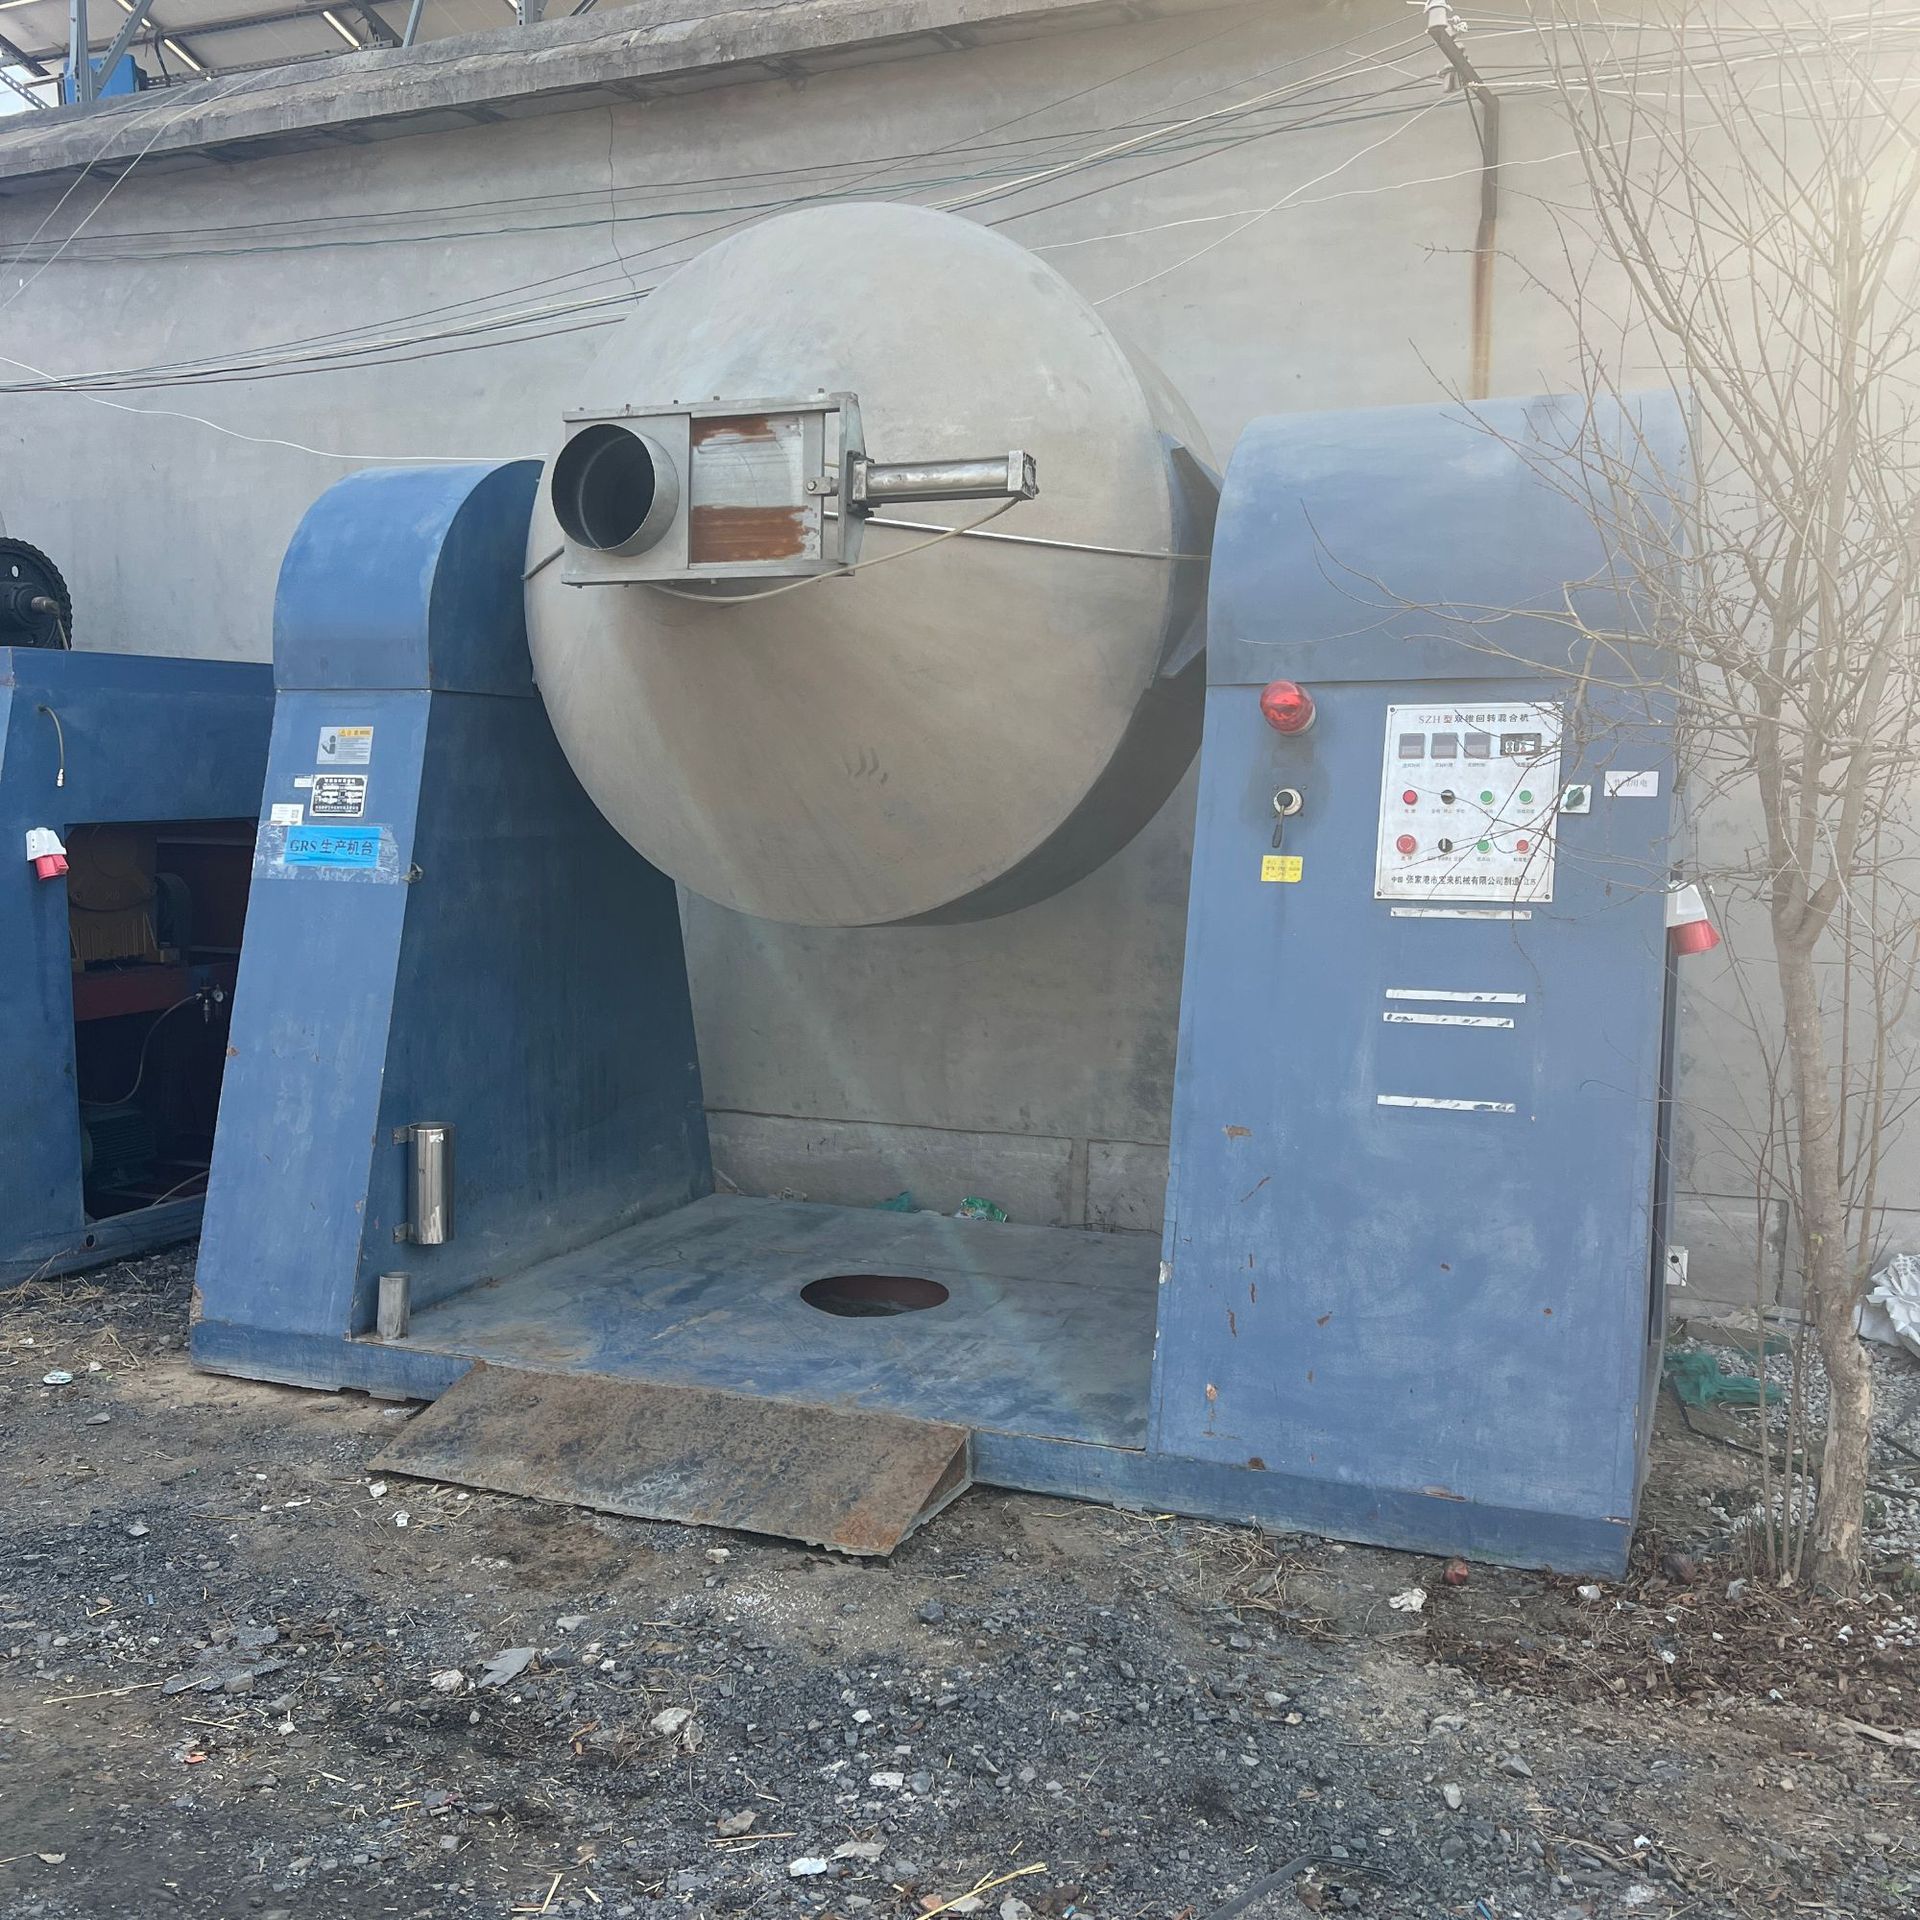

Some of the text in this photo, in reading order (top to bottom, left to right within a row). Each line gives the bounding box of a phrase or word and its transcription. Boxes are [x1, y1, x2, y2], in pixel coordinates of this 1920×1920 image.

[289, 839, 373, 856] GRS 生产机台
